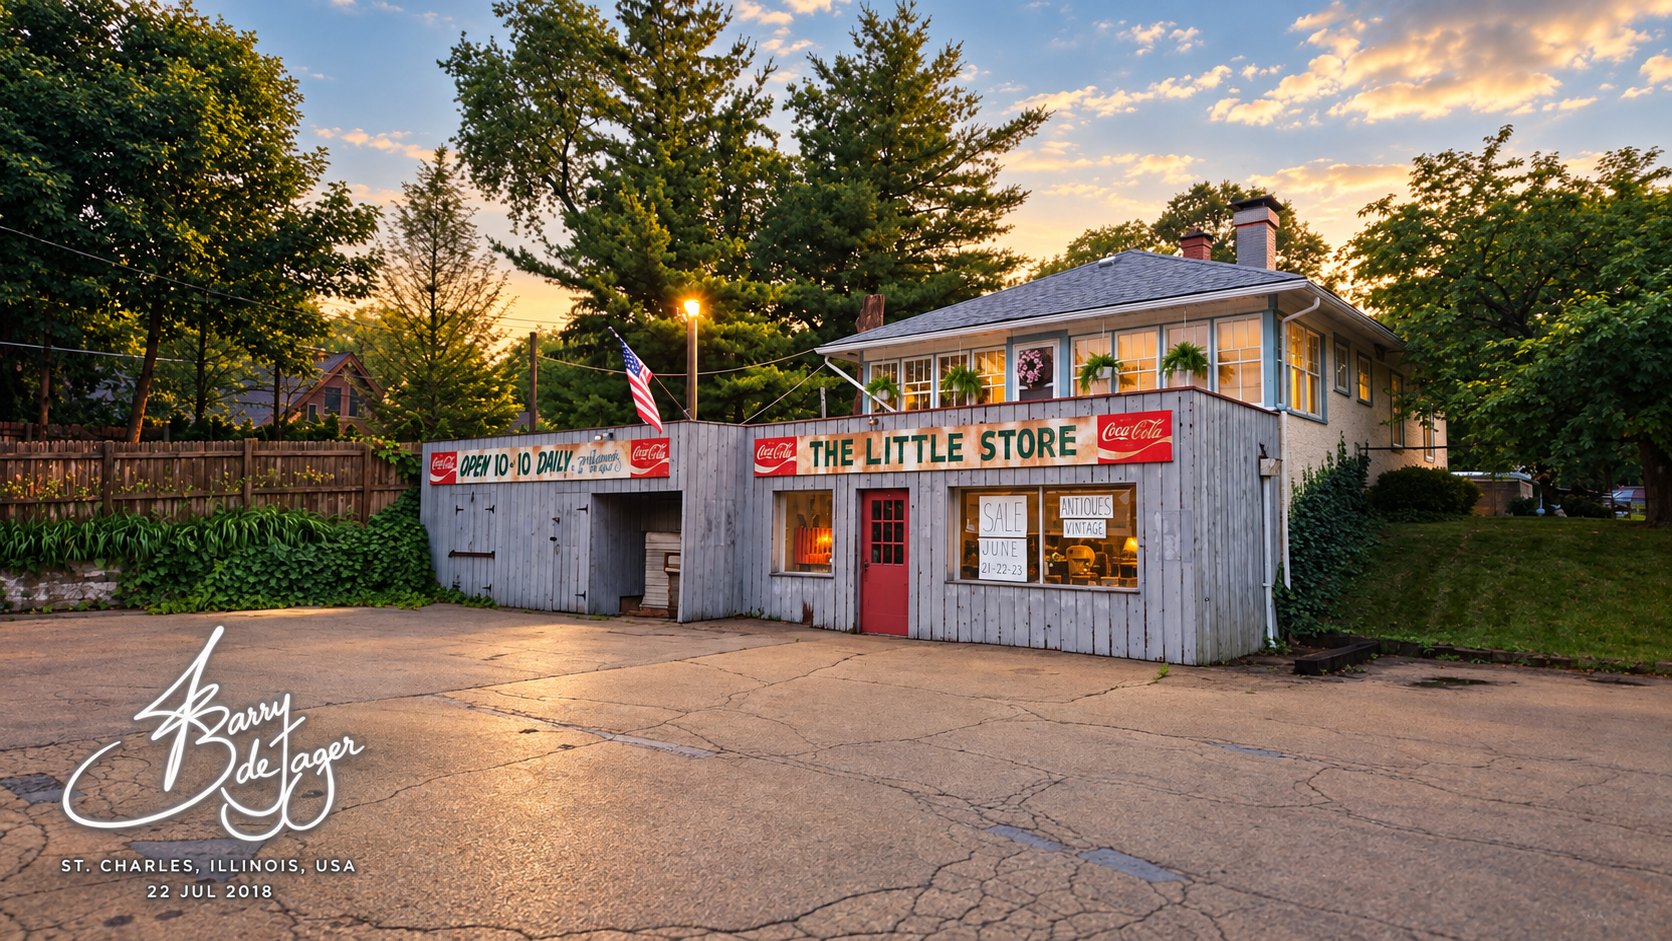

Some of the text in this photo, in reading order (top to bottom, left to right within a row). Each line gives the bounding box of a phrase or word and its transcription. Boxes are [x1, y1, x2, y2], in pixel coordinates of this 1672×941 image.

[809, 425, 1076, 467] THE LITTLE STORE
[460, 454, 491, 477] OPEN
[983, 502, 1023, 532] SALE
[1065, 521, 1103, 536] VINTAGE
[982, 540, 1018, 558] JUNE
[981, 562, 1023, 576] 21-22-23
